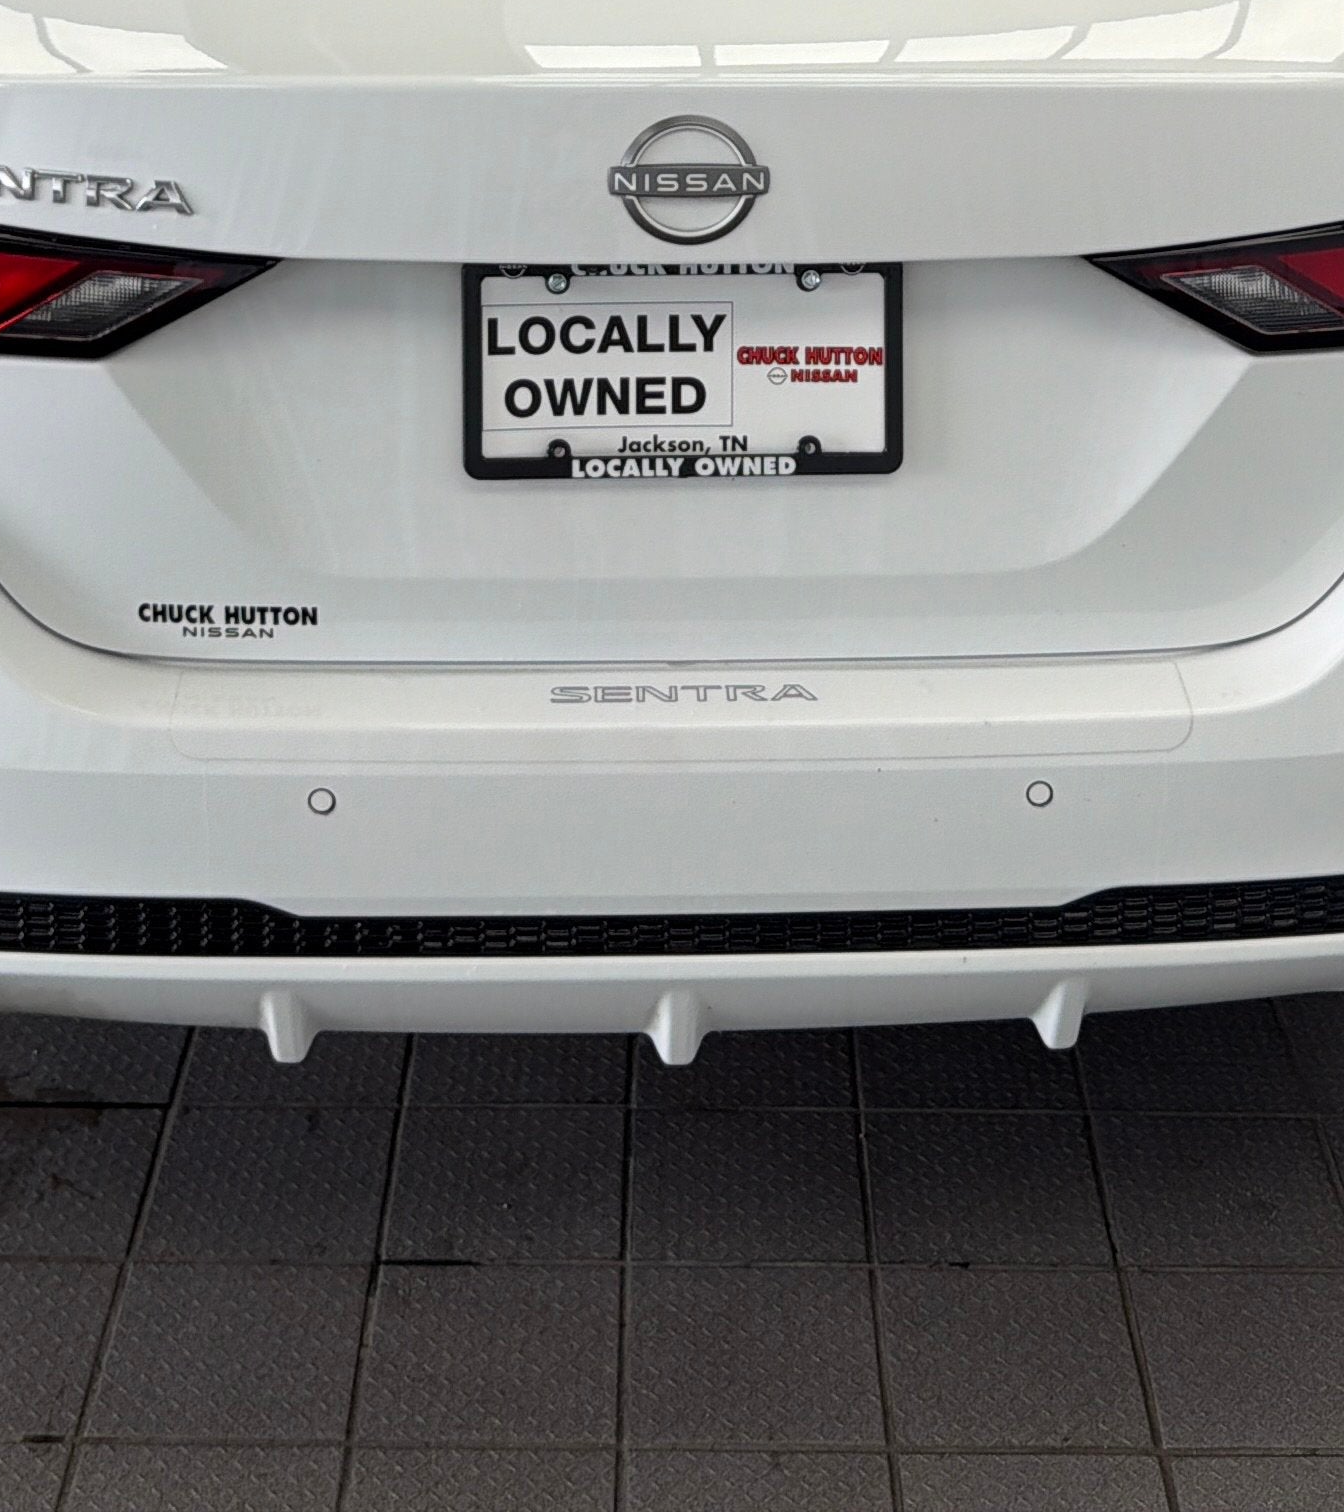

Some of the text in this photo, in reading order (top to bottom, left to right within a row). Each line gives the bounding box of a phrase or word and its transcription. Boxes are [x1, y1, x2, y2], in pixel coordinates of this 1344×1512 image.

[613, 171, 765, 193] NISSAN
[487, 313, 727, 356] LOCALLY
[736, 345, 884, 366] CHUCK HUTTON
[790, 368, 859, 384] NISSAN
[503, 376, 707, 419] OWNED
[617, 434, 749, 456] Jackson, TN
[571, 456, 798, 479] LOCALLY OWNED
[137, 602, 319, 626] CHUCK HUTTON
[182, 625, 275, 639] NISSAN
[550, 683, 819, 704] SENTRA
